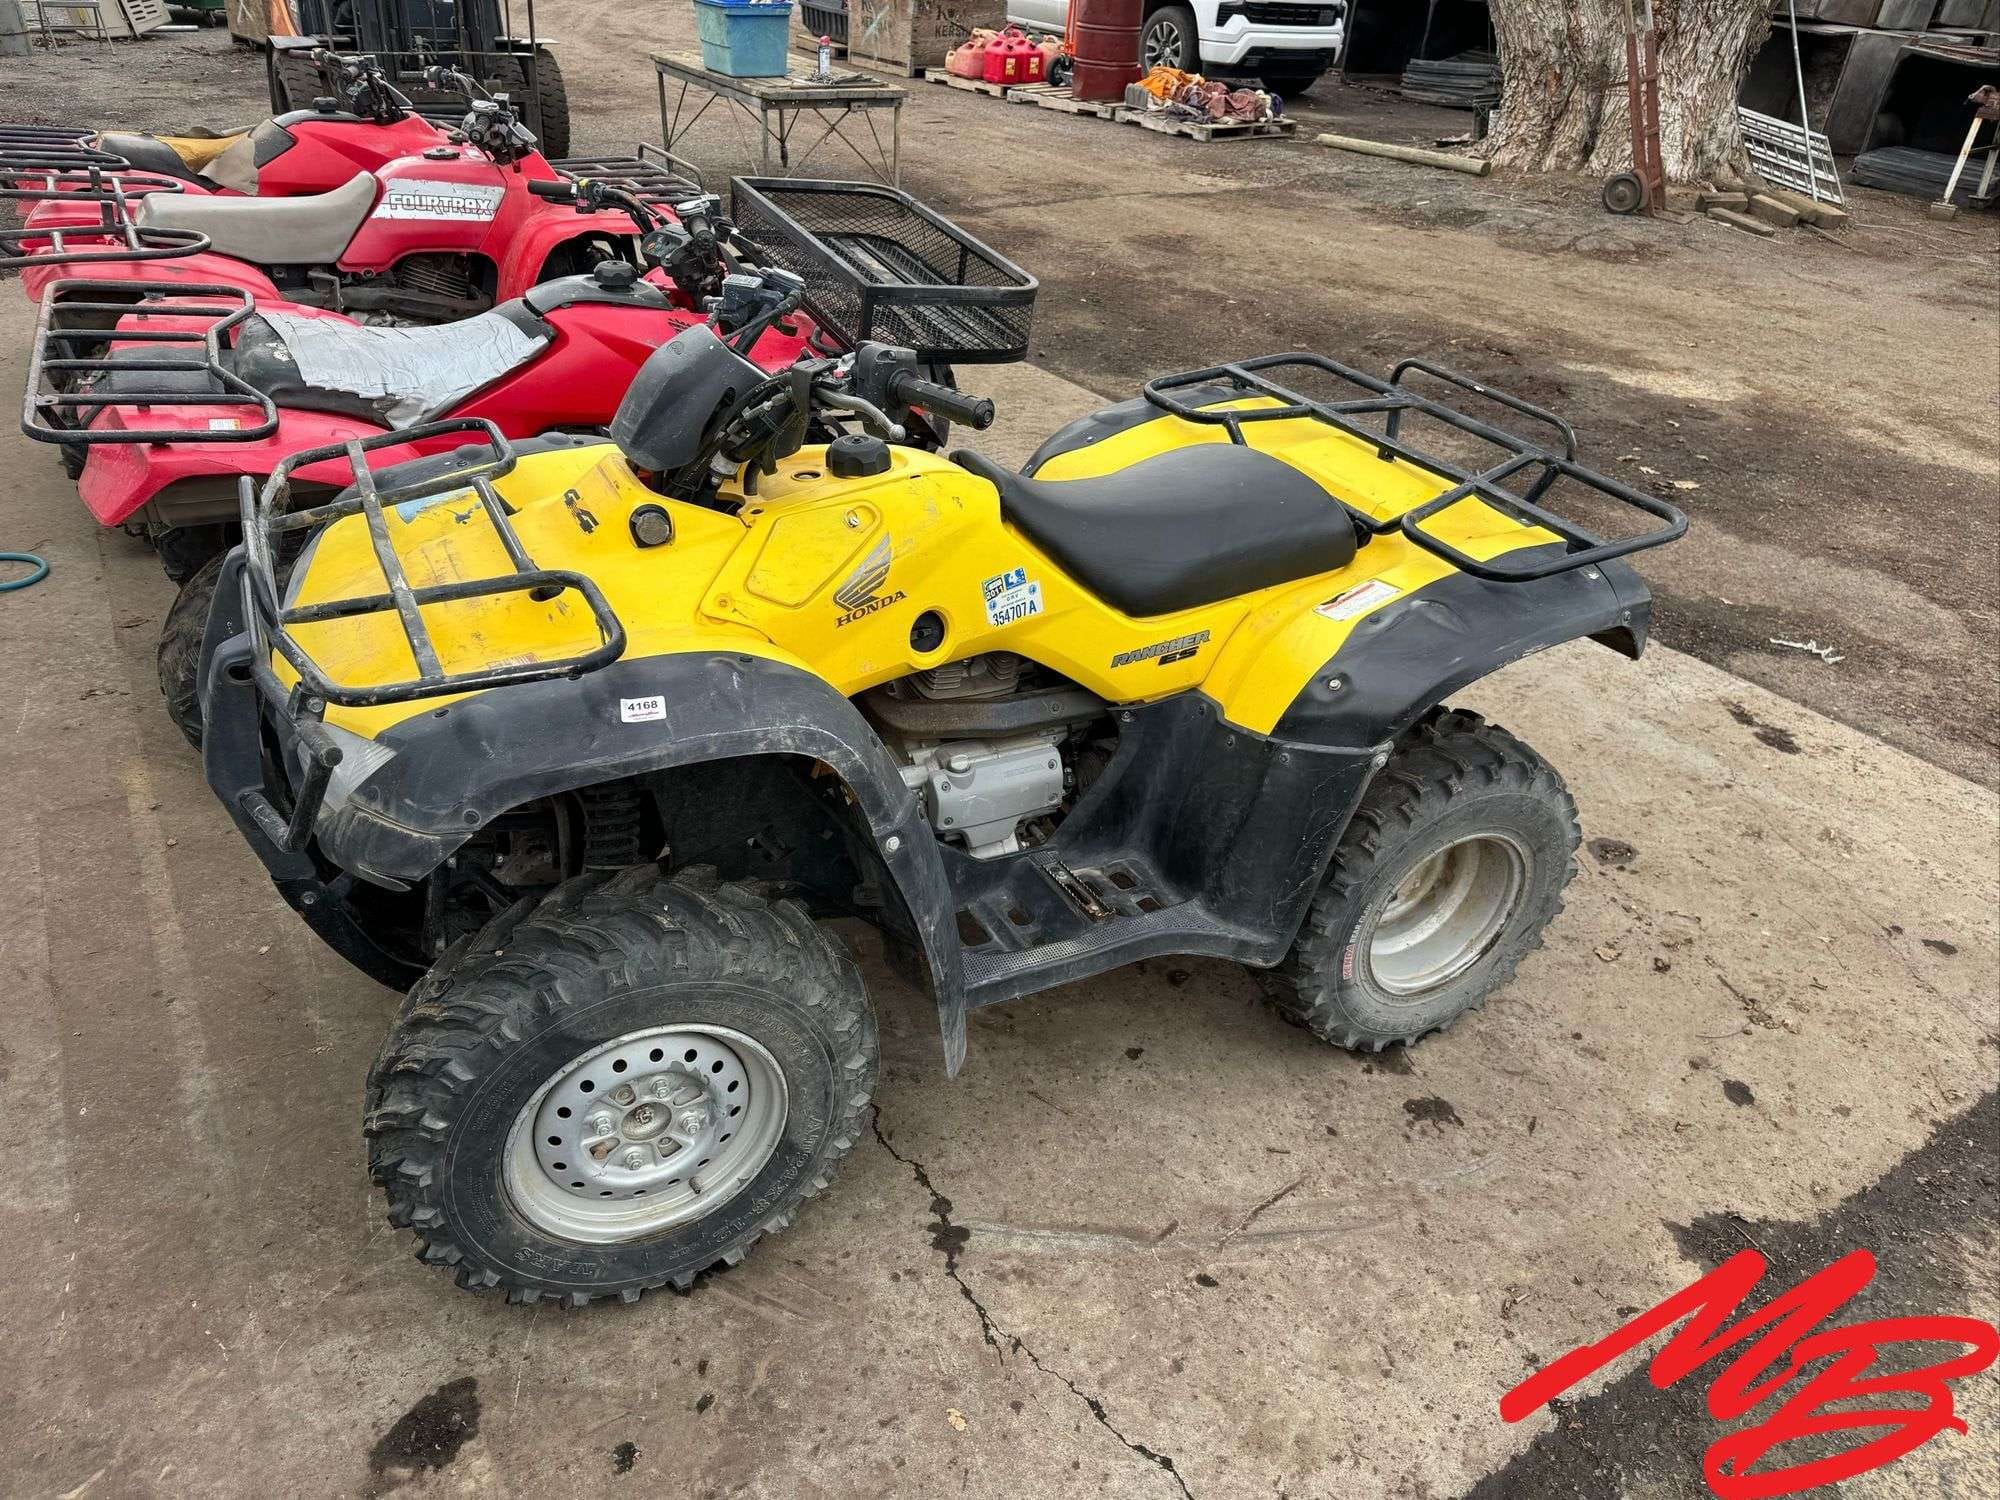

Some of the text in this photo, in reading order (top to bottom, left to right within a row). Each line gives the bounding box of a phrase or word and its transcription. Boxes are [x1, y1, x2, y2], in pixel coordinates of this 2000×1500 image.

[389, 194, 492, 216] FOURTRAX
[836, 590, 907, 629] HONDA
[1110, 629, 1210, 669] RANCHER
[1157, 645, 1200, 667] ES
[627, 700, 658, 711] 4168
